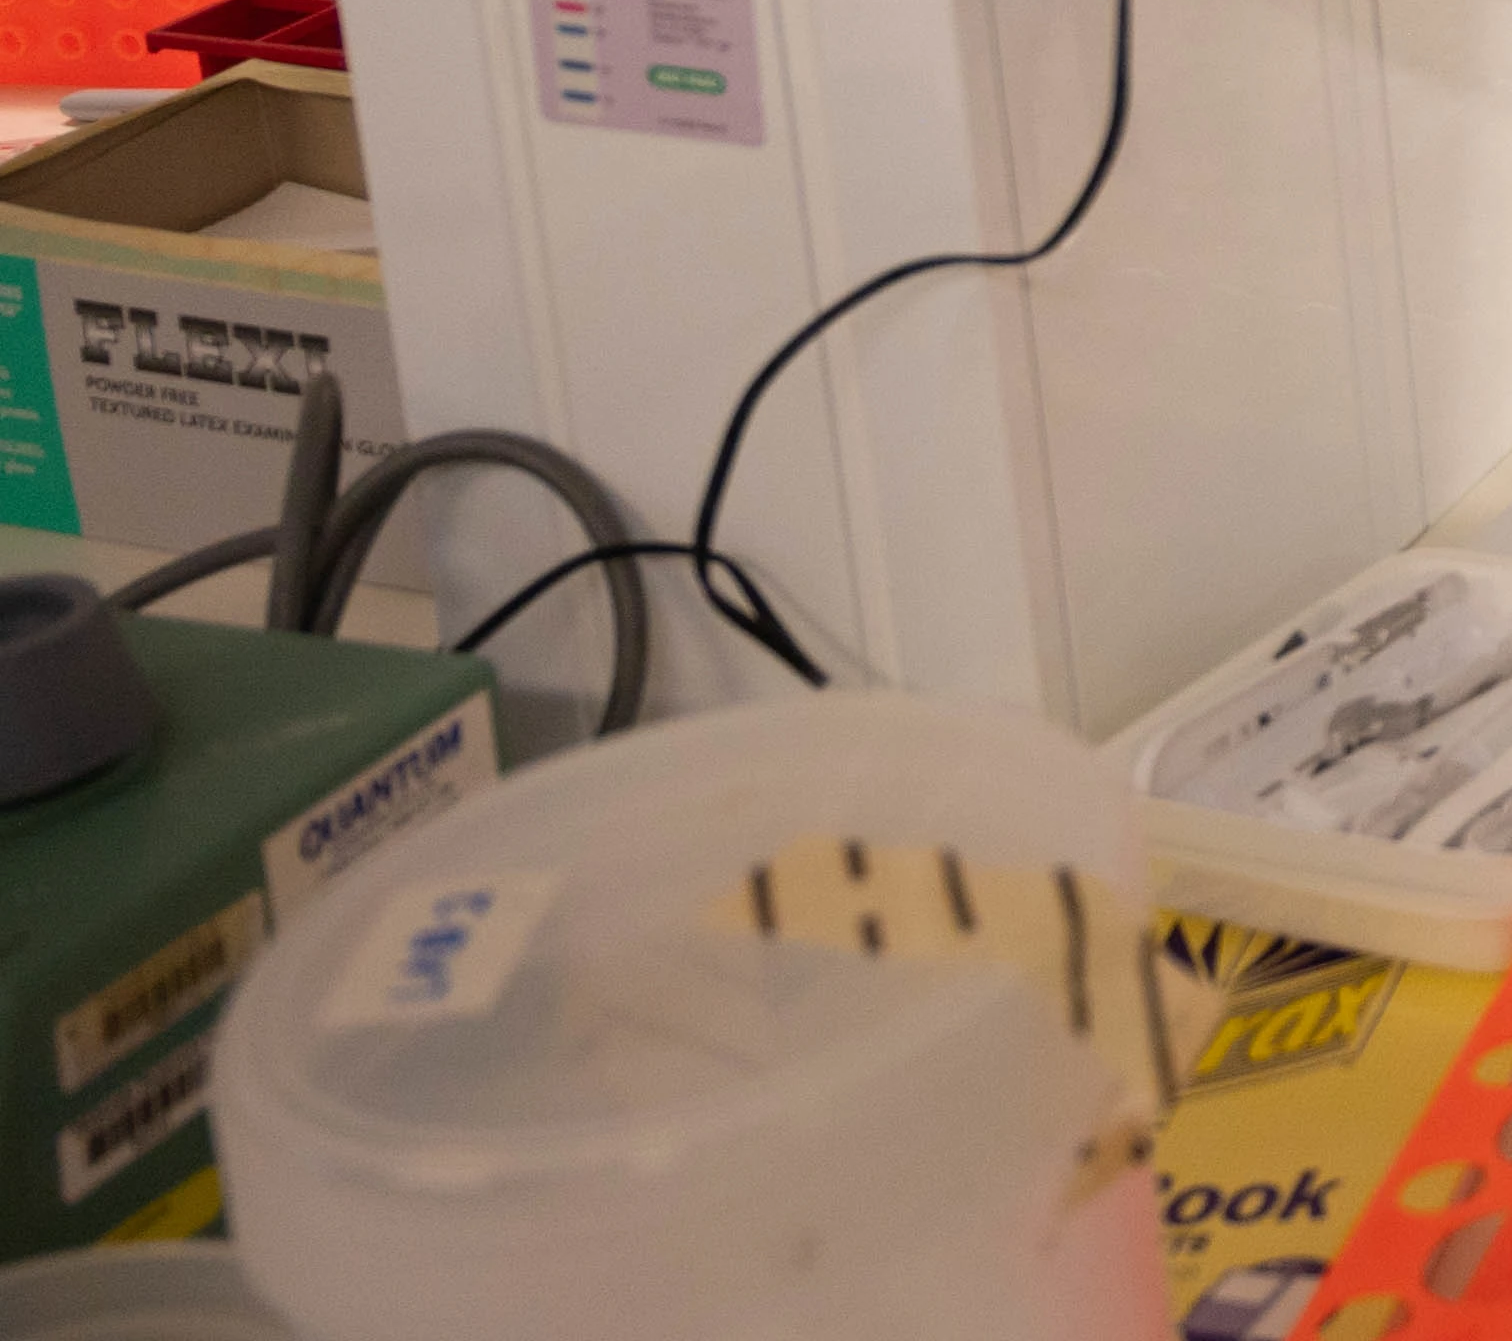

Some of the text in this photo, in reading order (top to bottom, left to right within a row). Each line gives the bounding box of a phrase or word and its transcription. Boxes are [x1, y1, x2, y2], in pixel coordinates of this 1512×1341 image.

[86, 374, 199, 405] POWDER FREE
[90, 396, 176, 424] TEXTURED
[180, 411, 231, 433] LATEX
[299, 719, 463, 864] QUANTUM
[1158, 1169, 1342, 1225] ook
